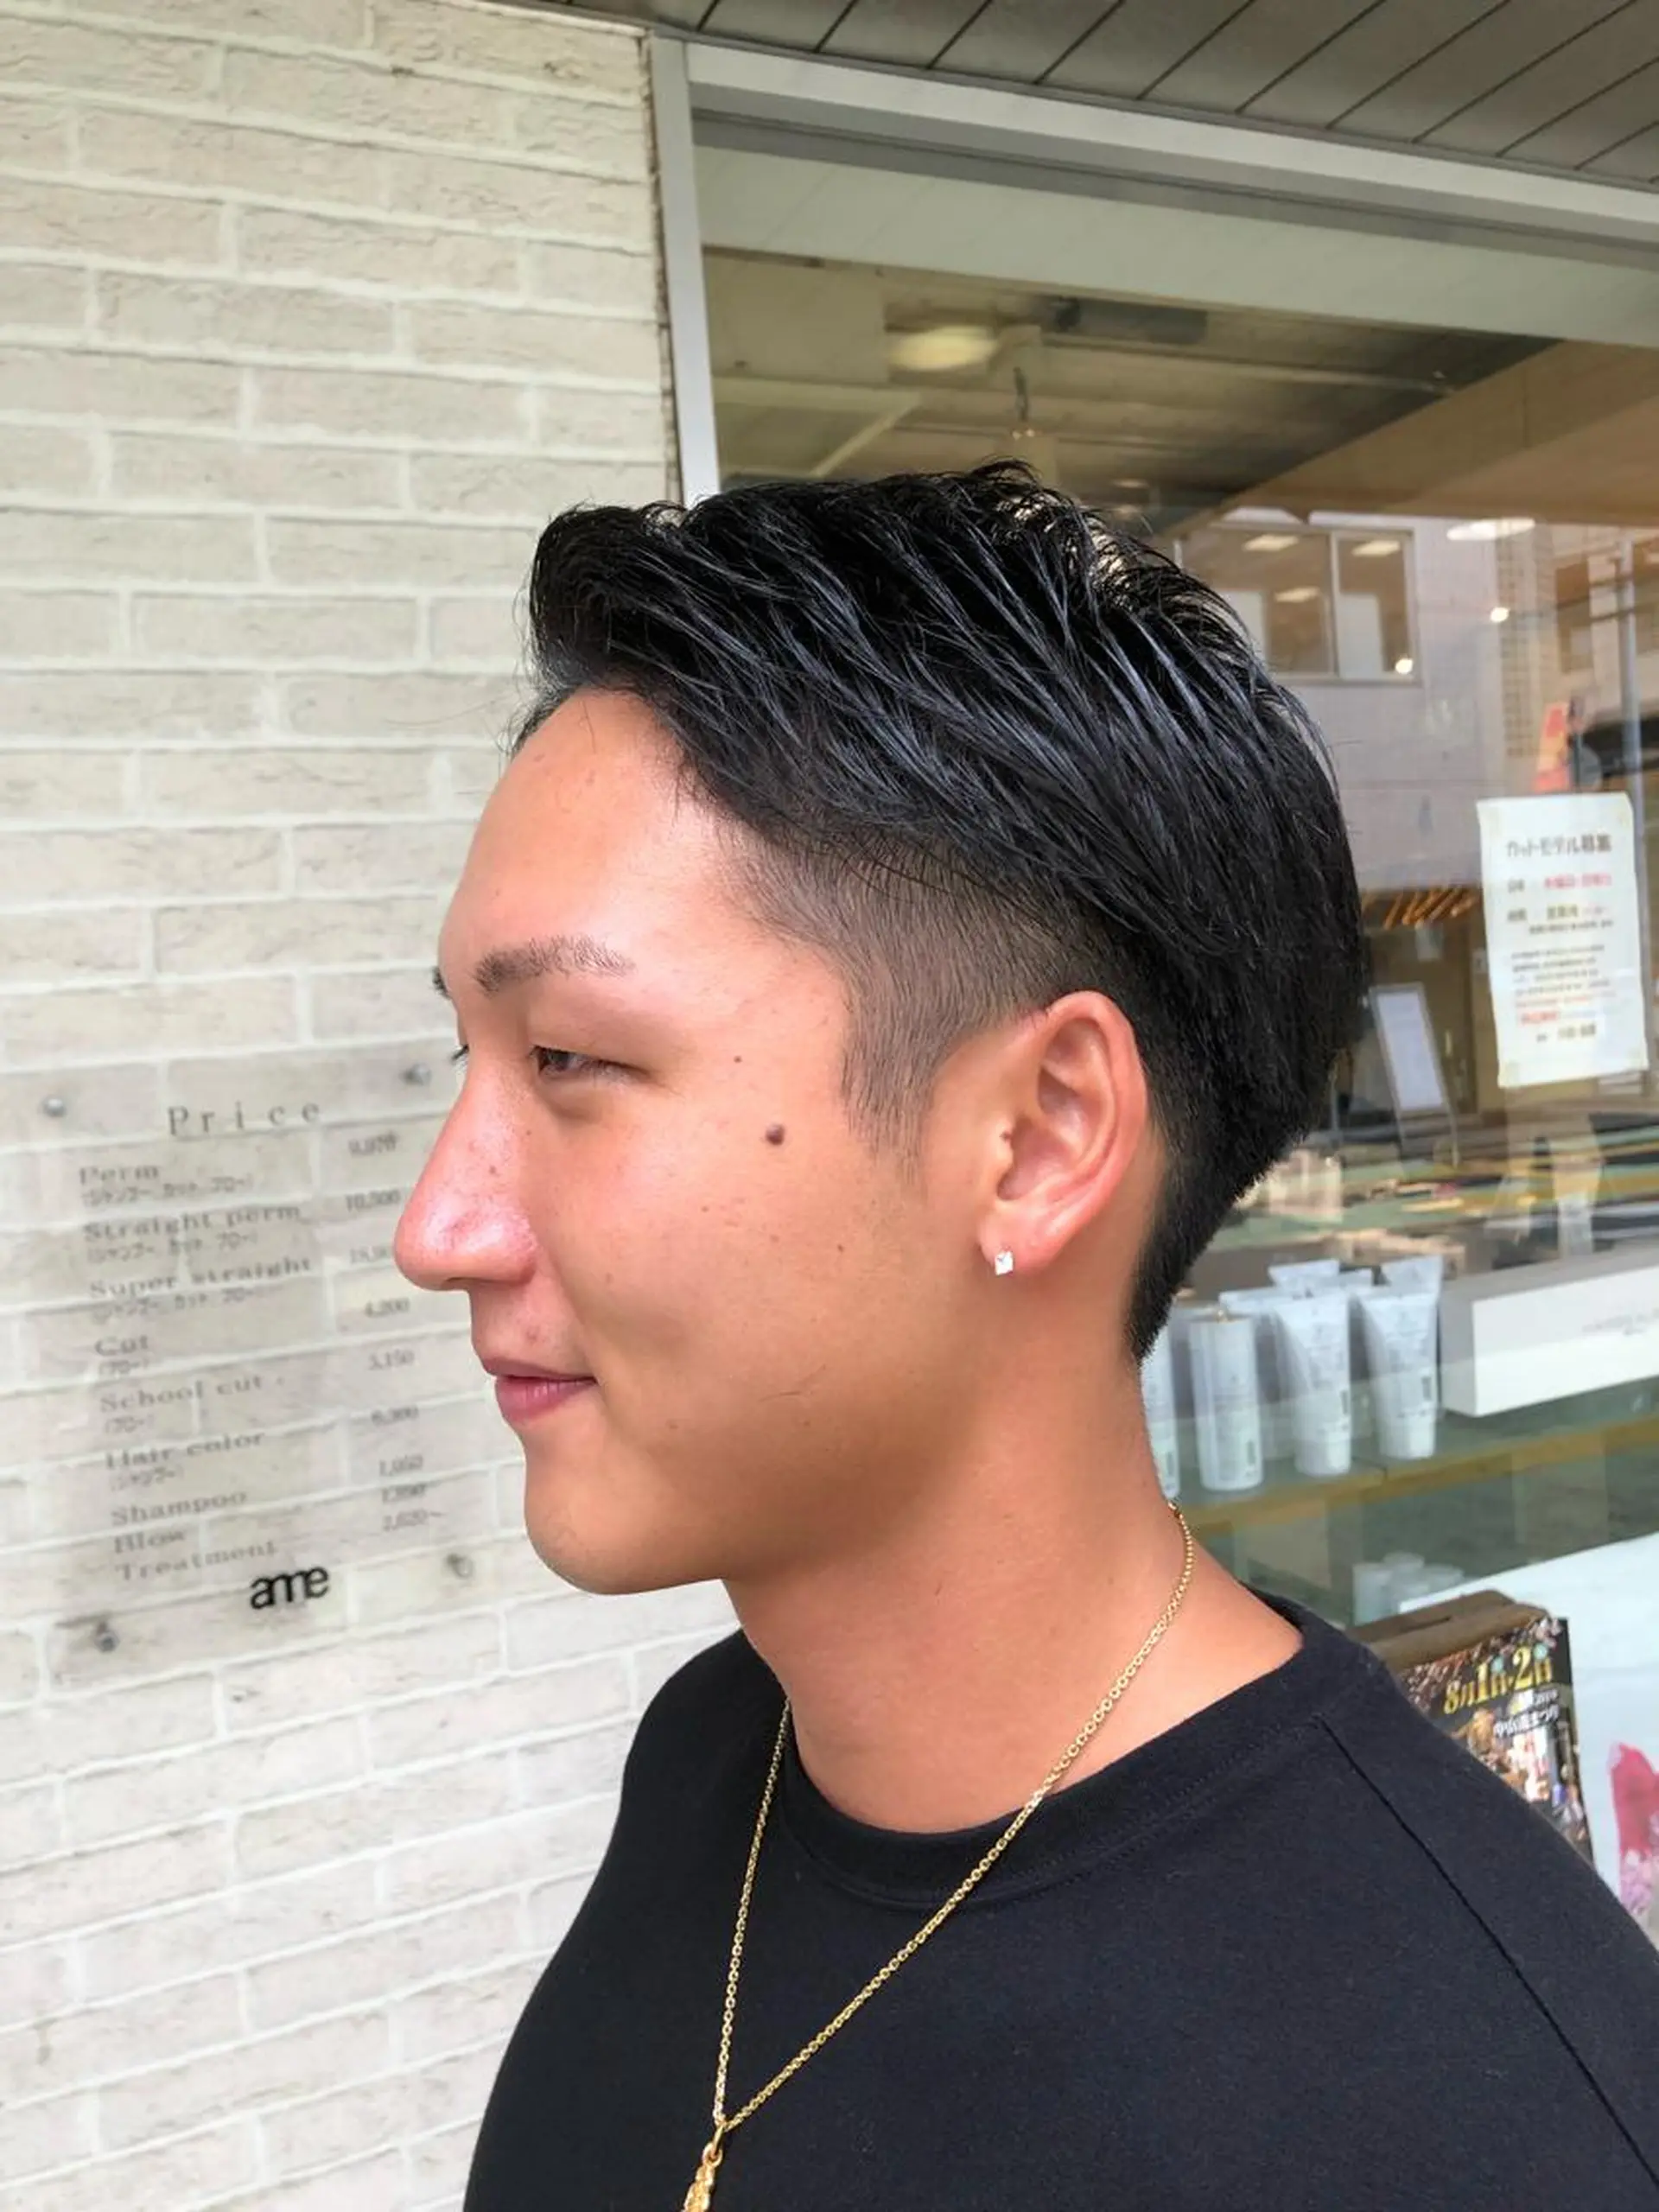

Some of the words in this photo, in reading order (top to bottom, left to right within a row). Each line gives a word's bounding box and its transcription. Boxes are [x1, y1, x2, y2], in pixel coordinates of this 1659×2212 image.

[168, 1100, 321, 1136] Price
[84, 1211, 212, 1242] Straight
[226, 1206, 301, 1228] perm
[90, 1275, 176, 1298] Super
[191, 1255, 311, 1285] straight
[95, 1334, 149, 1357] Cut
[100, 1380, 203, 1413] School
[217, 1376, 263, 1395] cut
[187, 1433, 264, 1457] color
[111, 1491, 247, 1527] Shampoo
[115, 1541, 280, 1580] Treatment
[250, 1566, 330, 1611] ame
